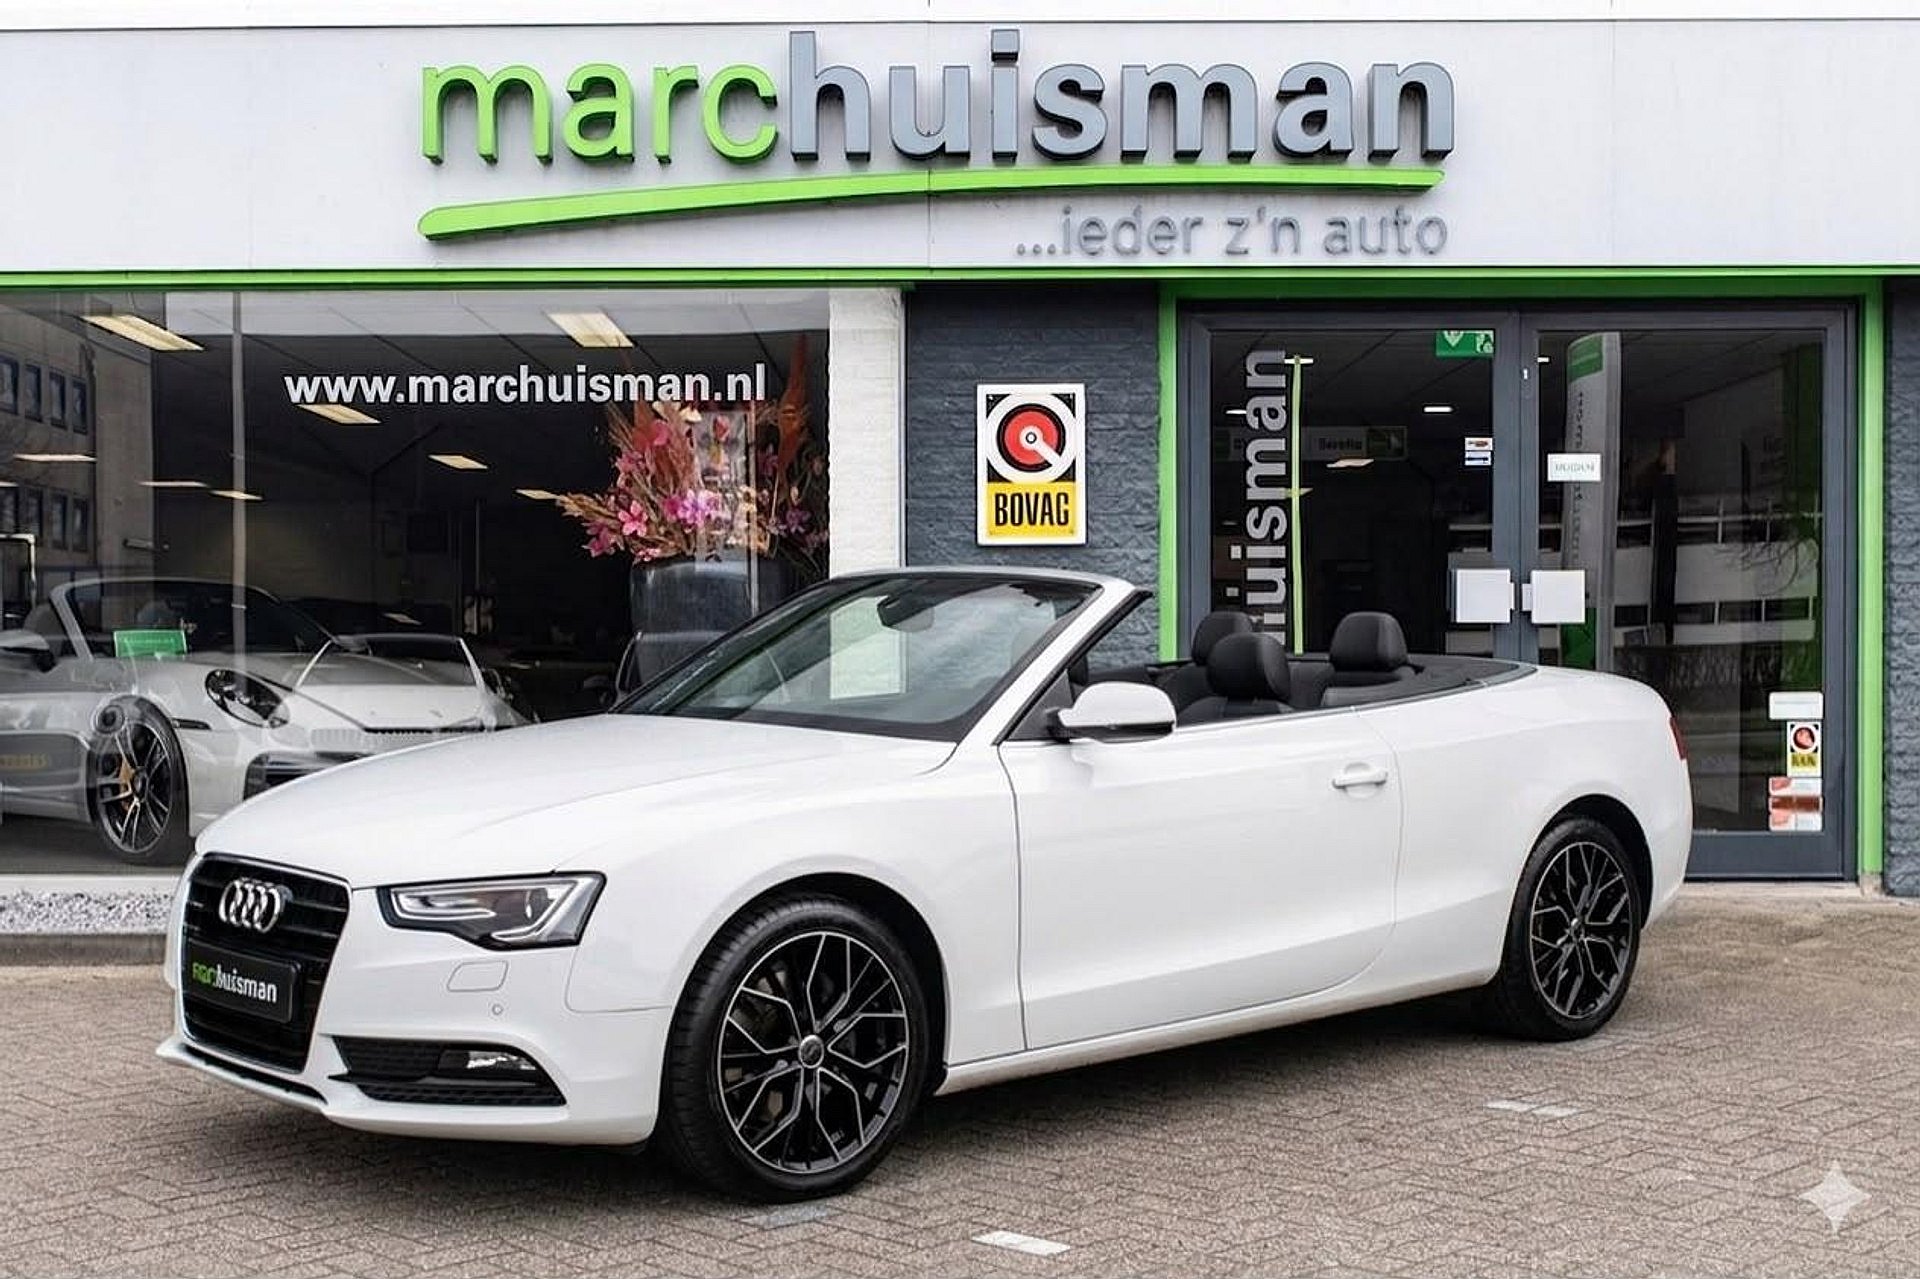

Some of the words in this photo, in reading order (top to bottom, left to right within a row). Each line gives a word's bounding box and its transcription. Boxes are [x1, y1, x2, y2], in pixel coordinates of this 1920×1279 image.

[421, 29, 1455, 164] marchuisman
[1225, 206, 1301, 255] z'n
[1323, 206, 1448, 255] auto
[284, 363, 766, 404] www.marchuisman.nl
[994, 492, 1069, 527] BOVAG
